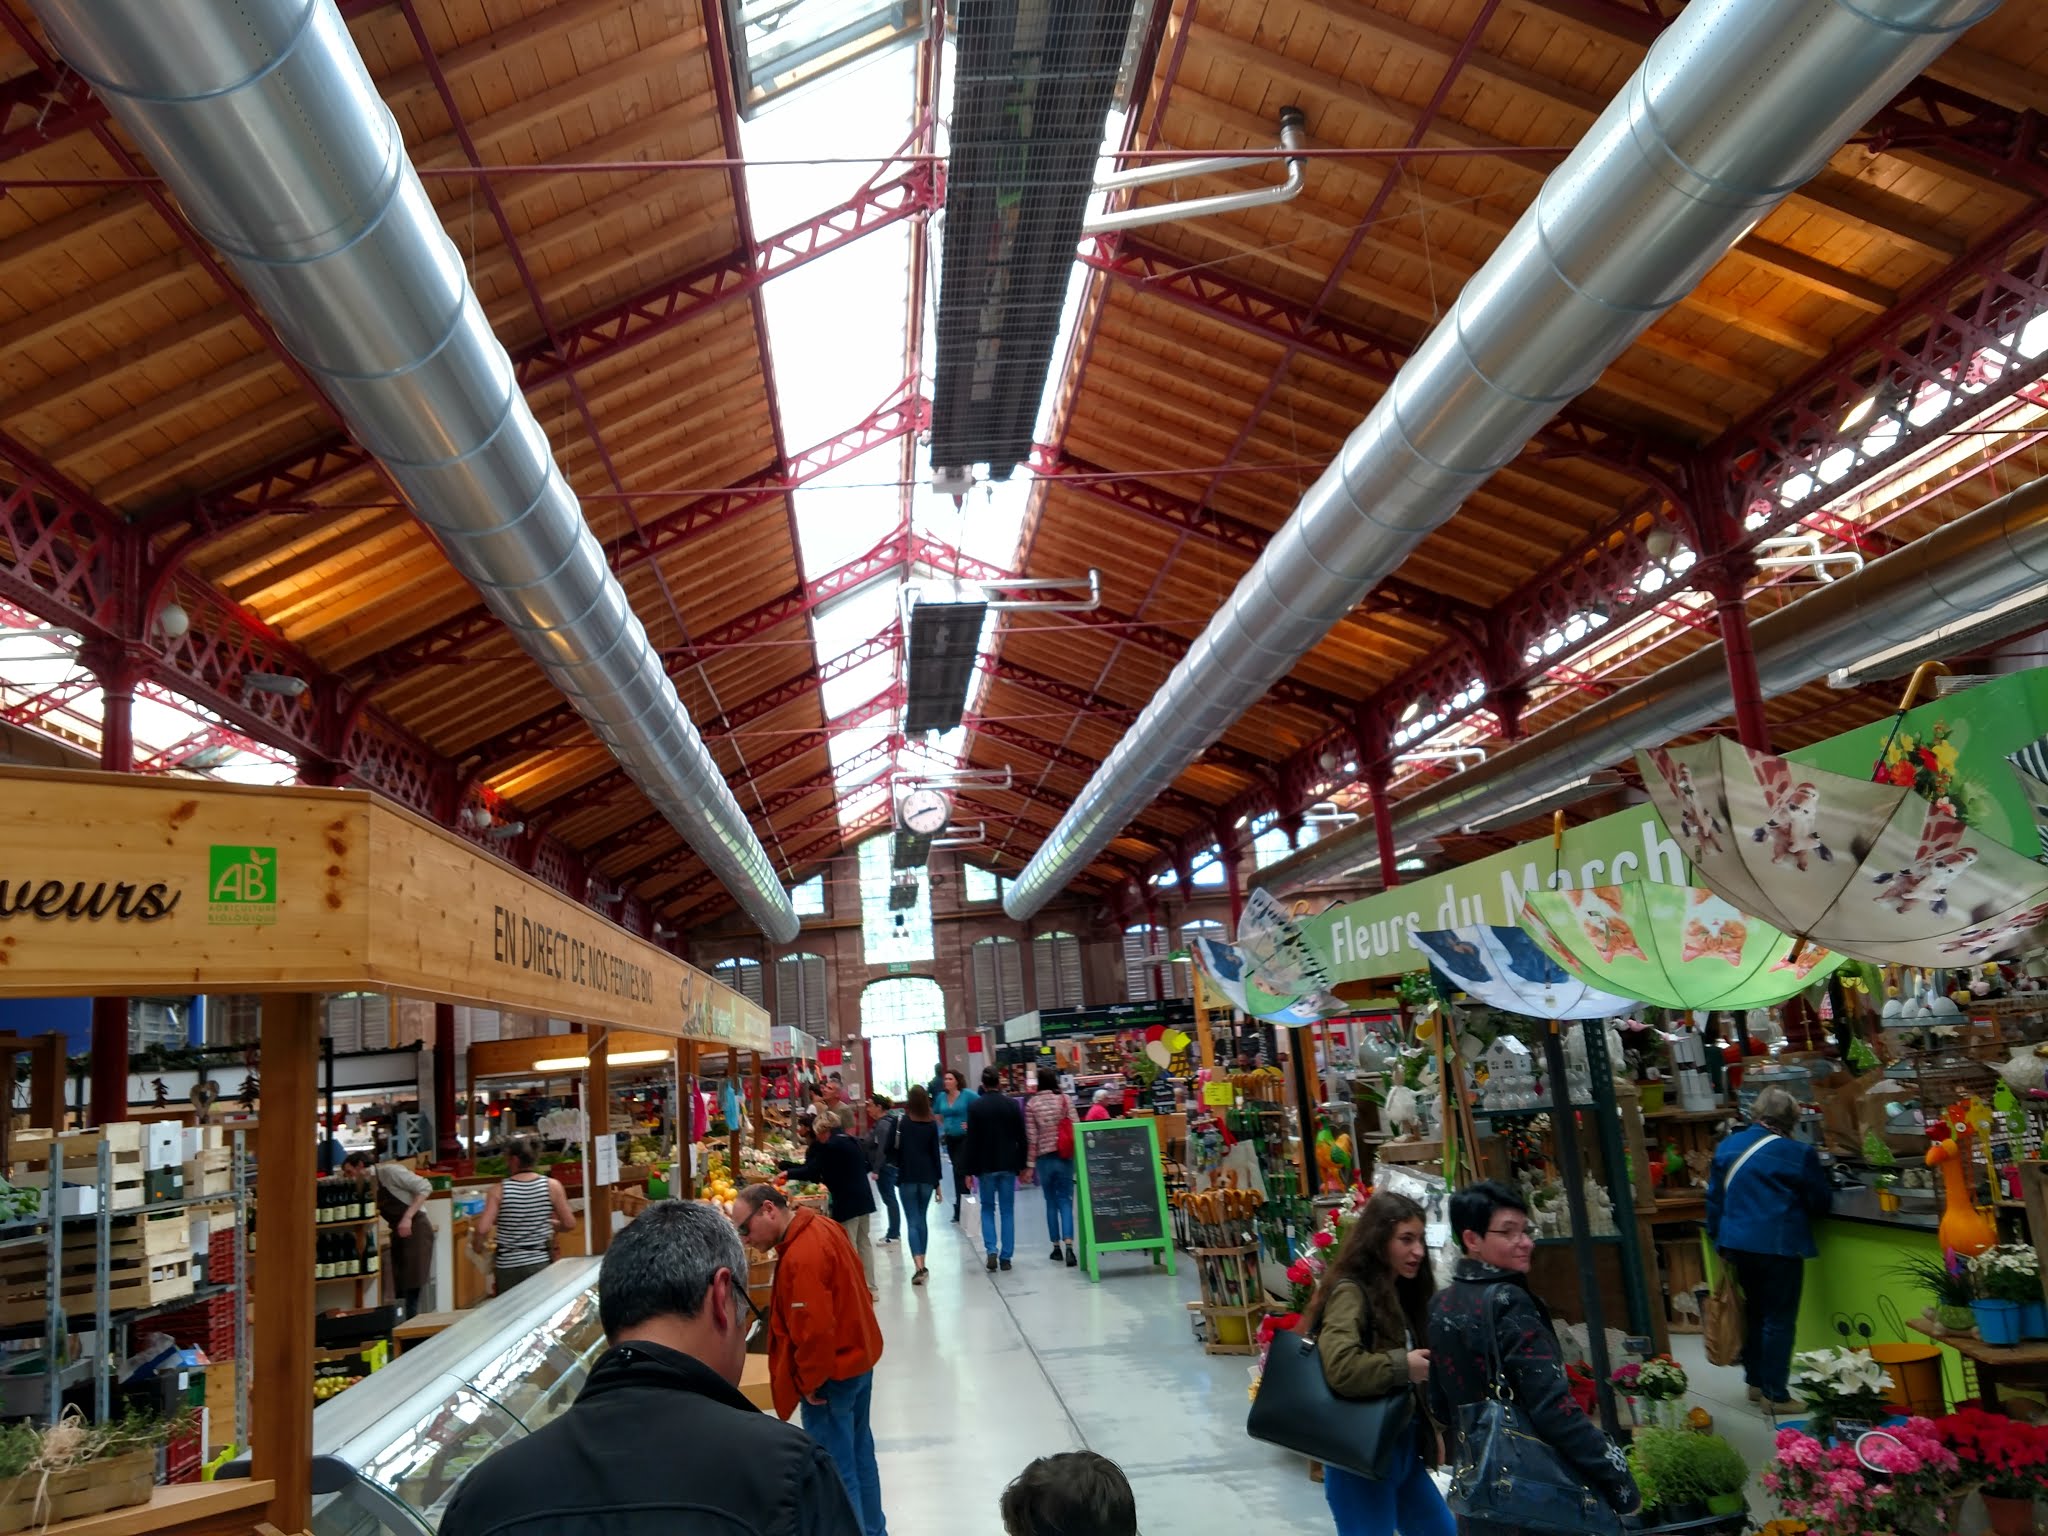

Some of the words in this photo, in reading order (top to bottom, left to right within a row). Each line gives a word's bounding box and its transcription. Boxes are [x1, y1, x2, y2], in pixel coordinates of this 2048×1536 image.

[214, 863, 267, 900] AB
[494, 905, 516, 966] EN
[522, 916, 568, 980] DIRECT
[571, 937, 586, 986] DE
[588, 945, 608, 992] NOS
[610, 954, 640, 1002] FERMES
[640, 967, 653, 1005] BIO
[1331, 911, 1421, 965] Fleurs
[1438, 884, 1485, 930] du
